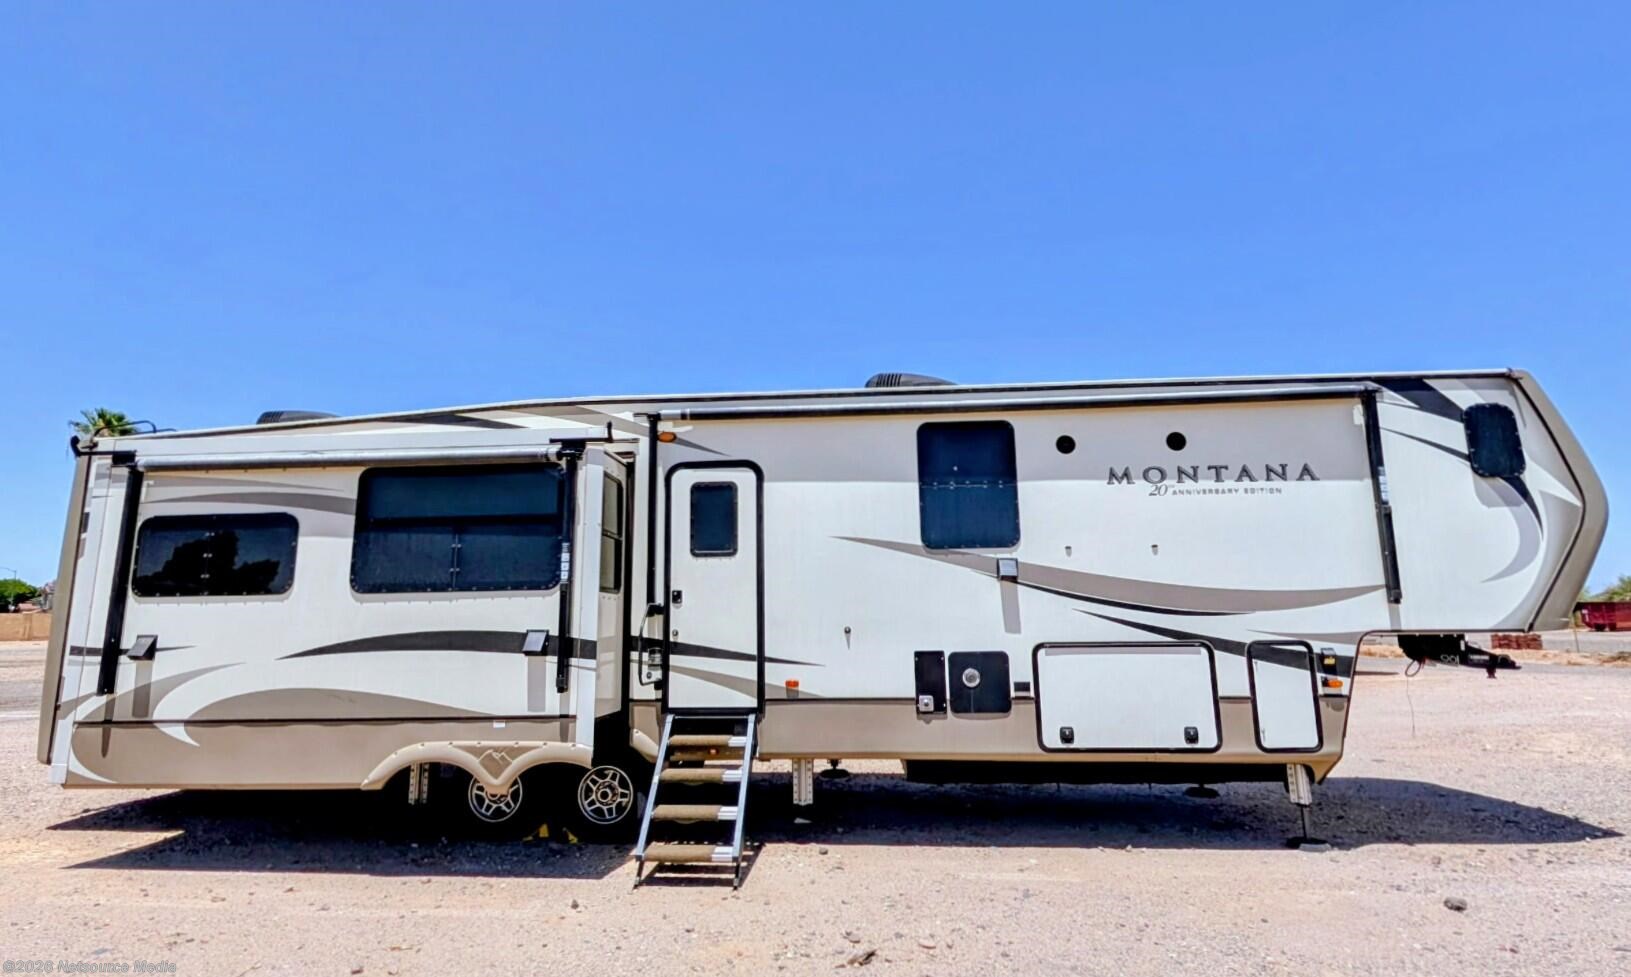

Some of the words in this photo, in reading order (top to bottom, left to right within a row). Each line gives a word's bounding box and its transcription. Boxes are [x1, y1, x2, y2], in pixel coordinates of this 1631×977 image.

[1106, 463, 1320, 485] MONTANA
[1172, 487, 1239, 496] ANNIVERSARY
[1244, 487, 1282, 495] EDITION
